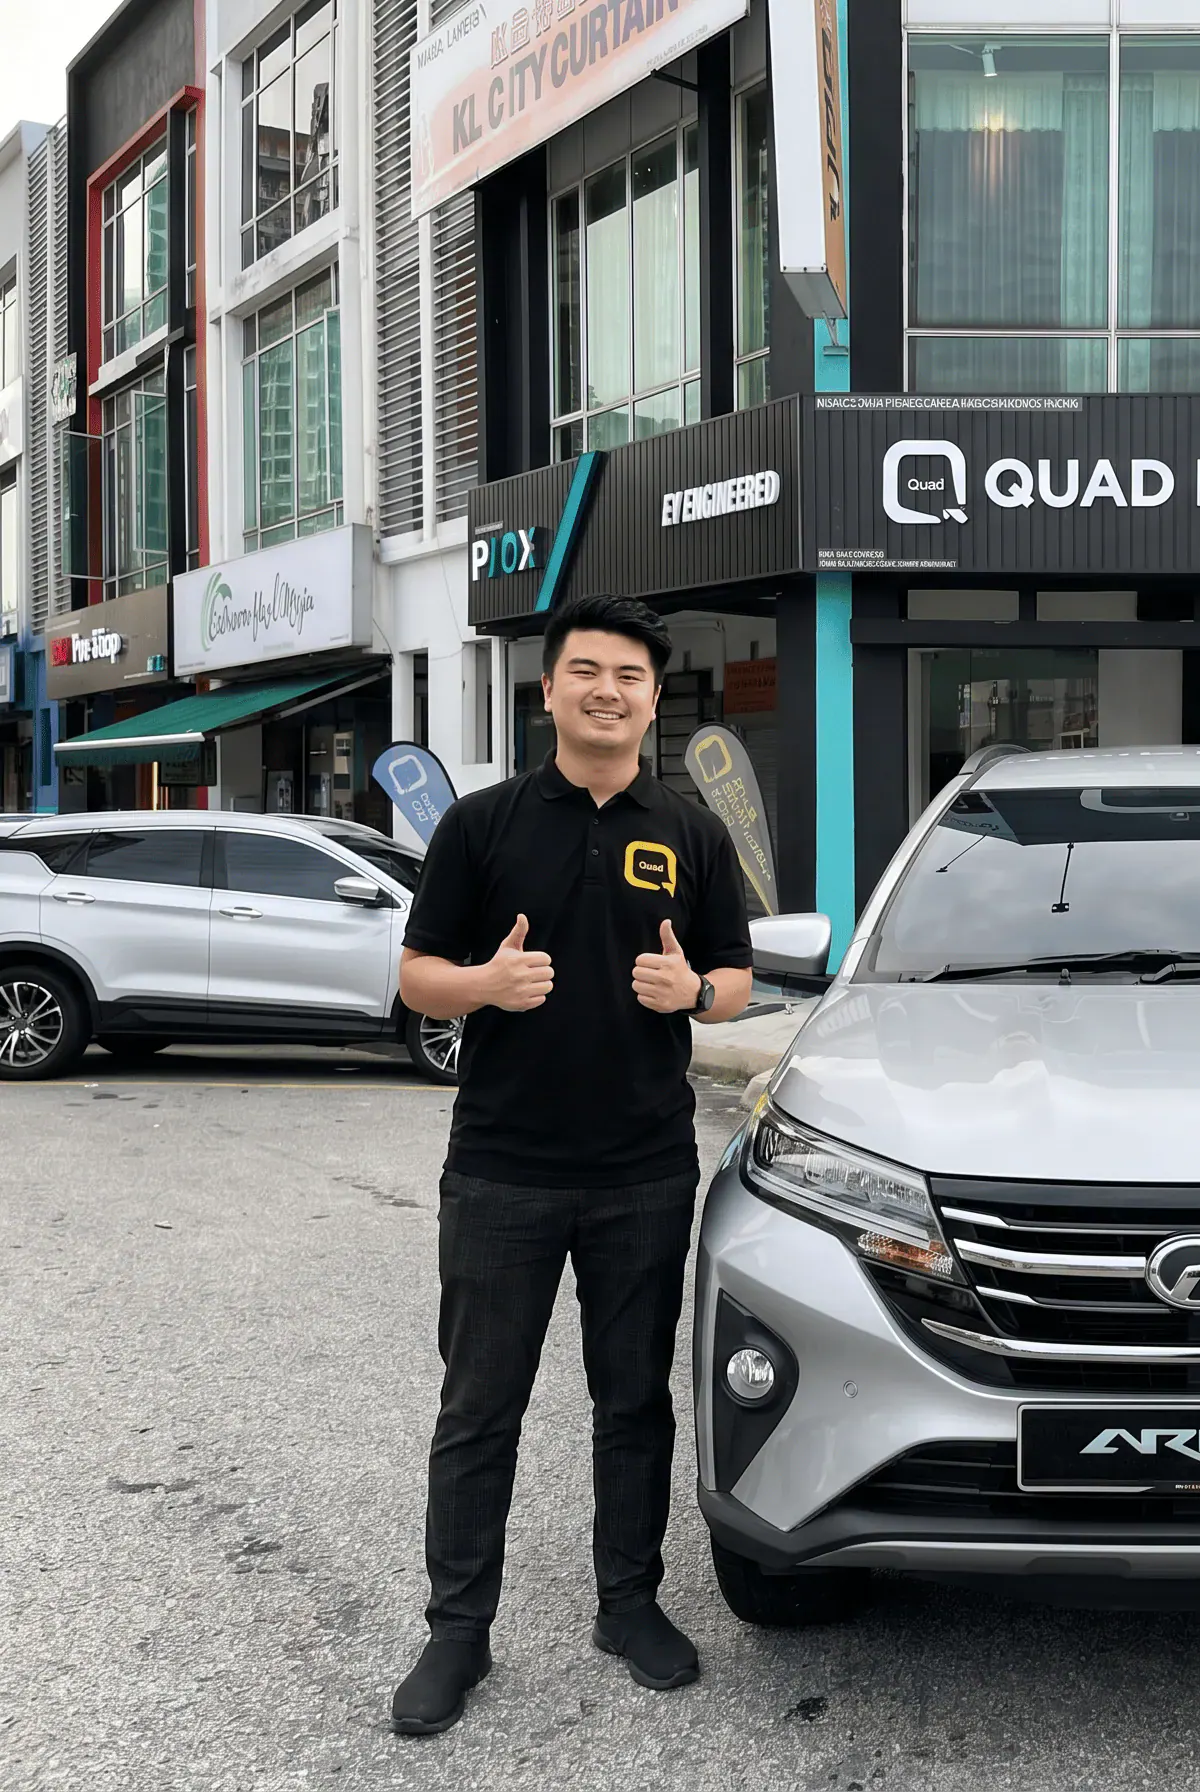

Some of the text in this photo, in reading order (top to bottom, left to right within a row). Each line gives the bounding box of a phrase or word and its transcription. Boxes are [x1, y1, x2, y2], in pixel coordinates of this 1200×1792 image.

[453, 93, 482, 154] KL
[682, 470, 781, 522] ENGINEERED
[907, 477, 945, 491] Quad
[984, 457, 1175, 508] QUAD
